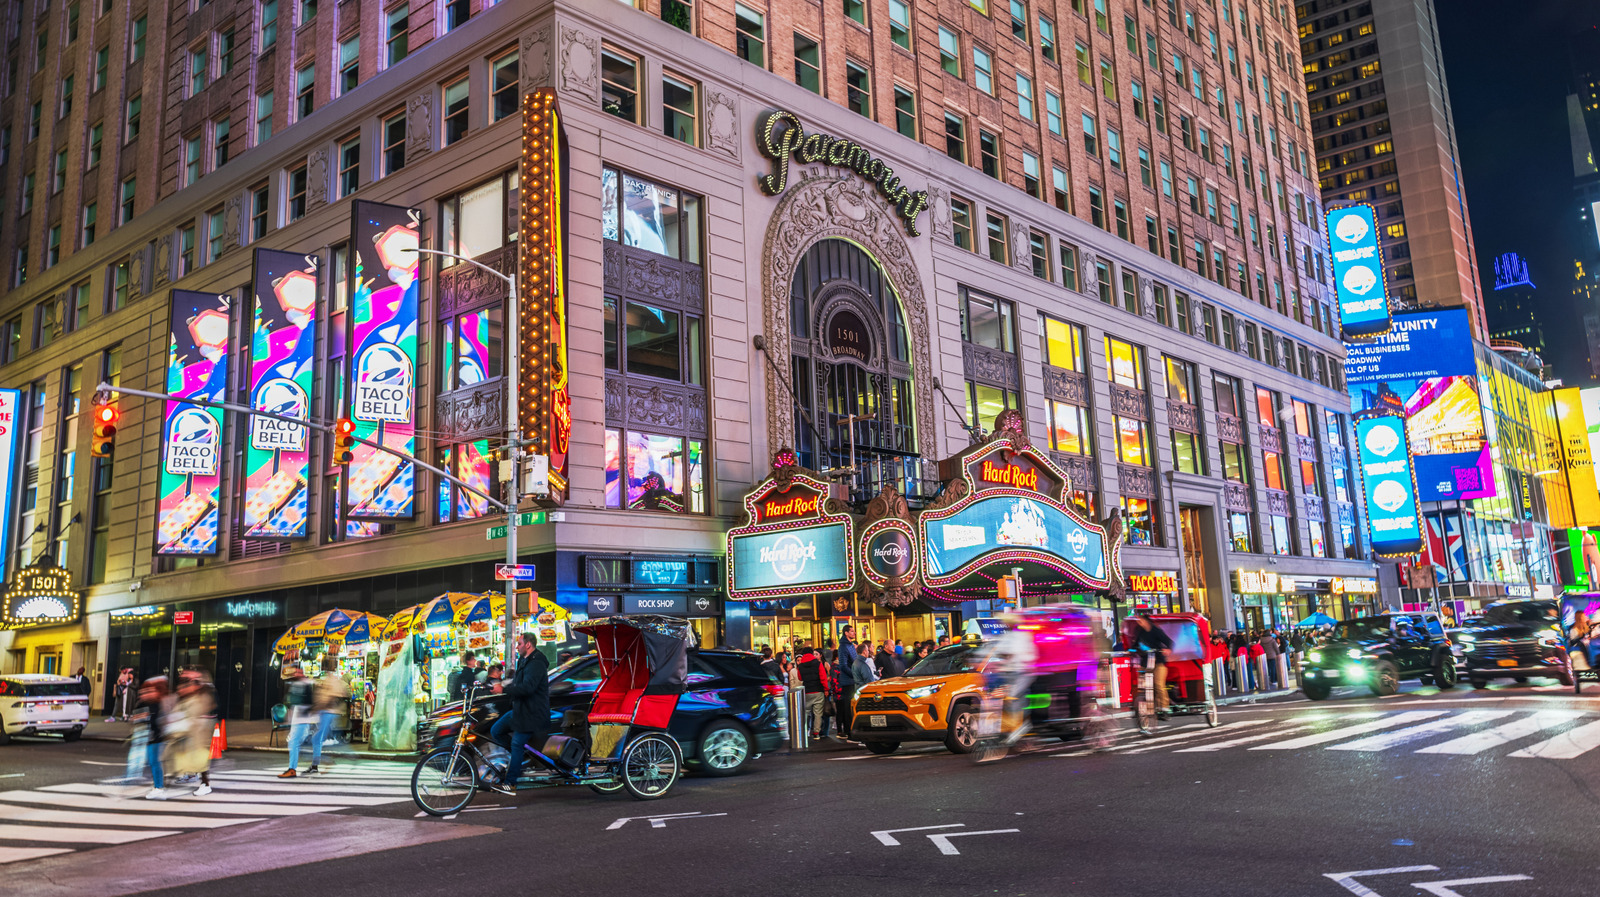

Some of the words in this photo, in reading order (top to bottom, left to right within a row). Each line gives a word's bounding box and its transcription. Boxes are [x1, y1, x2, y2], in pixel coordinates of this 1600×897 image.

[759, 109, 929, 237] Paramount
[1391, 318, 1438, 332] TUNITY
[837, 327, 859, 343] 1501
[832, 345, 866, 361] BROADWAY
[1365, 344, 1410, 354] BUSINESSES
[1357, 365, 1367, 373] OF
[1369, 364, 1380, 372] US
[360, 386, 404, 401] TACO
[361, 401, 402, 415] BELL
[257, 418, 299, 432] TACO
[259, 431, 297, 444] BELL
[171, 445, 211, 458] TACO
[172, 457, 209, 469] BELL
[983, 460, 1011, 484] Hard
[1012, 465, 1038, 492] Rock
[766, 499, 793, 517] Hard
[794, 495, 818, 516] Rock
[526, 514, 531, 524] 7
[497, 527, 504, 537] 43
[760, 543, 788, 564] Hard
[788, 541, 816, 562] Rock
[874, 548, 892, 557] Hard
[892, 547, 908, 558] Rock
[32, 576, 57, 590] 1501
[1129, 575, 1154, 592] TACO
[1156, 576, 1178, 592] BELL
[638, 599, 656, 608] ROCK
[657, 599, 675, 608] SHOP
[296, 628, 324, 637] SABRETT
[277, 641, 304, 652] SABRETT
